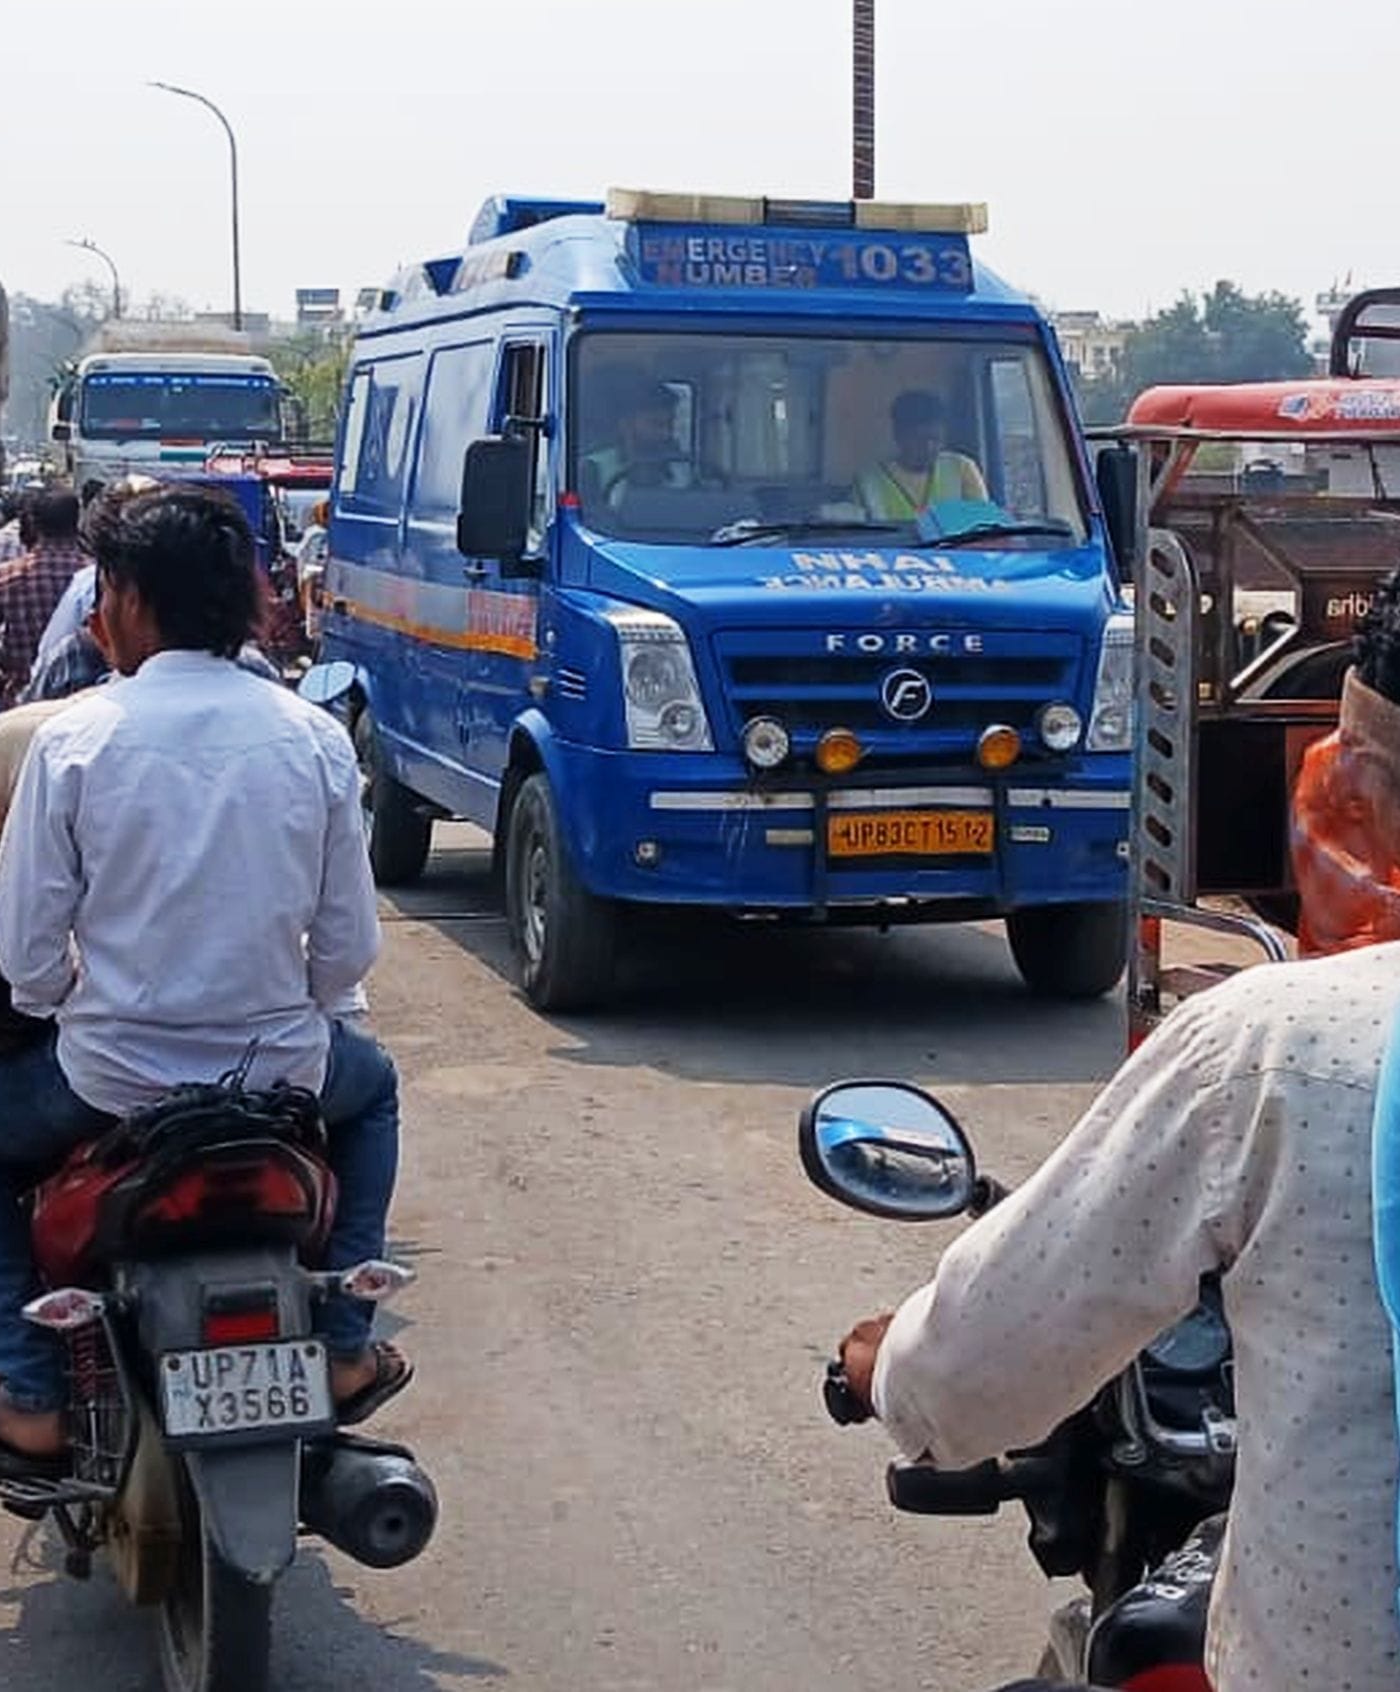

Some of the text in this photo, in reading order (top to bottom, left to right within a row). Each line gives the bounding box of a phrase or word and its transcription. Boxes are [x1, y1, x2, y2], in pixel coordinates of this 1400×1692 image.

[641, 236, 828, 267] EMERGENCY
[836, 242, 971, 285] 1033
[657, 262, 818, 288] NUMBER
[791, 552, 957, 572] NHAI
[826, 634, 984, 652] FORCE
[191, 1348, 306, 1390] UP71A
[195, 1385, 310, 1428] X3566
